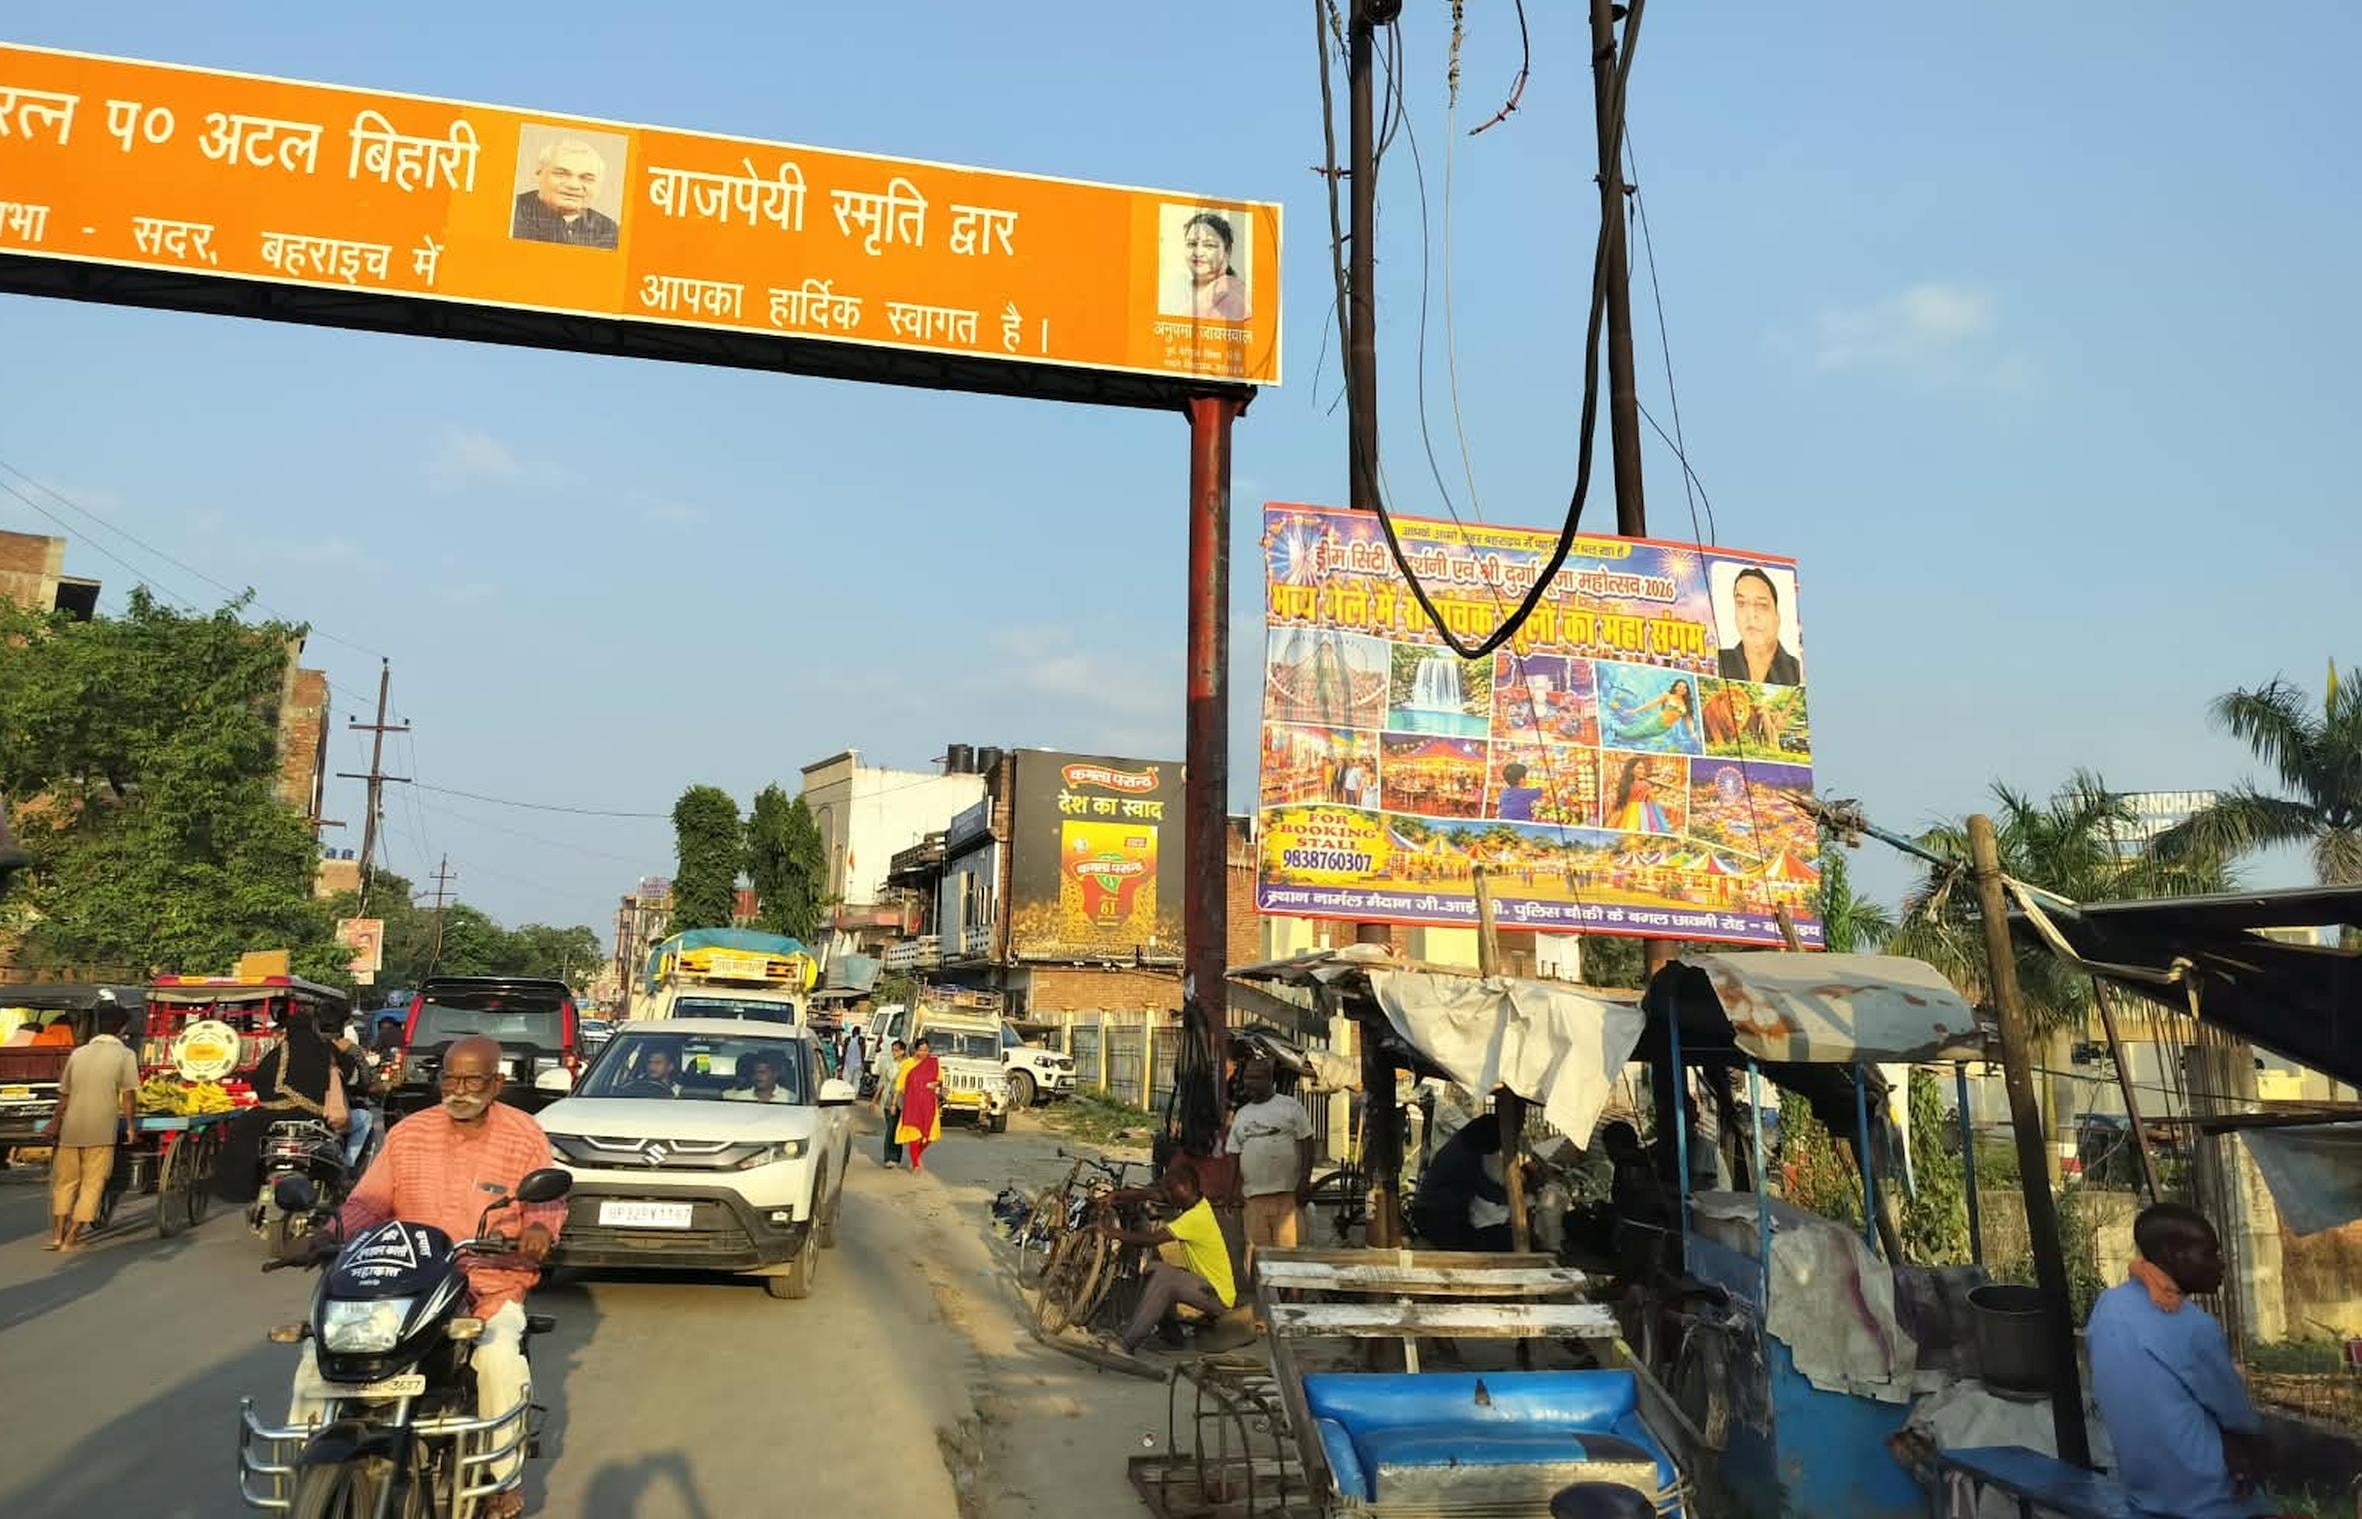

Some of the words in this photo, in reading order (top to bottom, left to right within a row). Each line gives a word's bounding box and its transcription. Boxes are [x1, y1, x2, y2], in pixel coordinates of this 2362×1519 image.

[198, 110, 323, 175] अटल
[347, 109, 480, 193] बिहारी
[648, 159, 807, 232] बाजपेयी
[831, 178, 928, 256] स्मृति
[949, 202, 1018, 256] द्वार
[0, 203, 50, 243] भा
[132, 215, 218, 265] सदर,
[260, 229, 391, 285] बहराइच
[412, 234, 444, 286] में
[639, 275, 744, 320] आपका
[769, 280, 862, 331] हार्दिक
[885, 302, 978, 346] स्वागत
[1001, 304, 1024, 353] है
[1315, 539, 1346, 572] ड्रीम
[1351, 543, 1386, 571] सिटी
[1505, 560, 1537, 593] दुर्गा
[1577, 565, 1641, 594] महोत्सव
[1644, 578, 1675, 598] 2026
[1560, 607, 1597, 648] का
[1601, 612, 1647, 654] महा
[1649, 609, 1707, 660] संगम
[1057, 789, 1089, 815] देश
[1092, 797, 1118, 816] का
[1121, 799, 1164, 820] स्वाद
[1280, 823, 1377, 840] BOOKING
[1308, 813, 1348, 825] FOR
[1297, 836, 1357, 850] STALL
[1283, 849, 1372, 873] 9838760307
[1313, 889, 1363, 908] नार्मल
